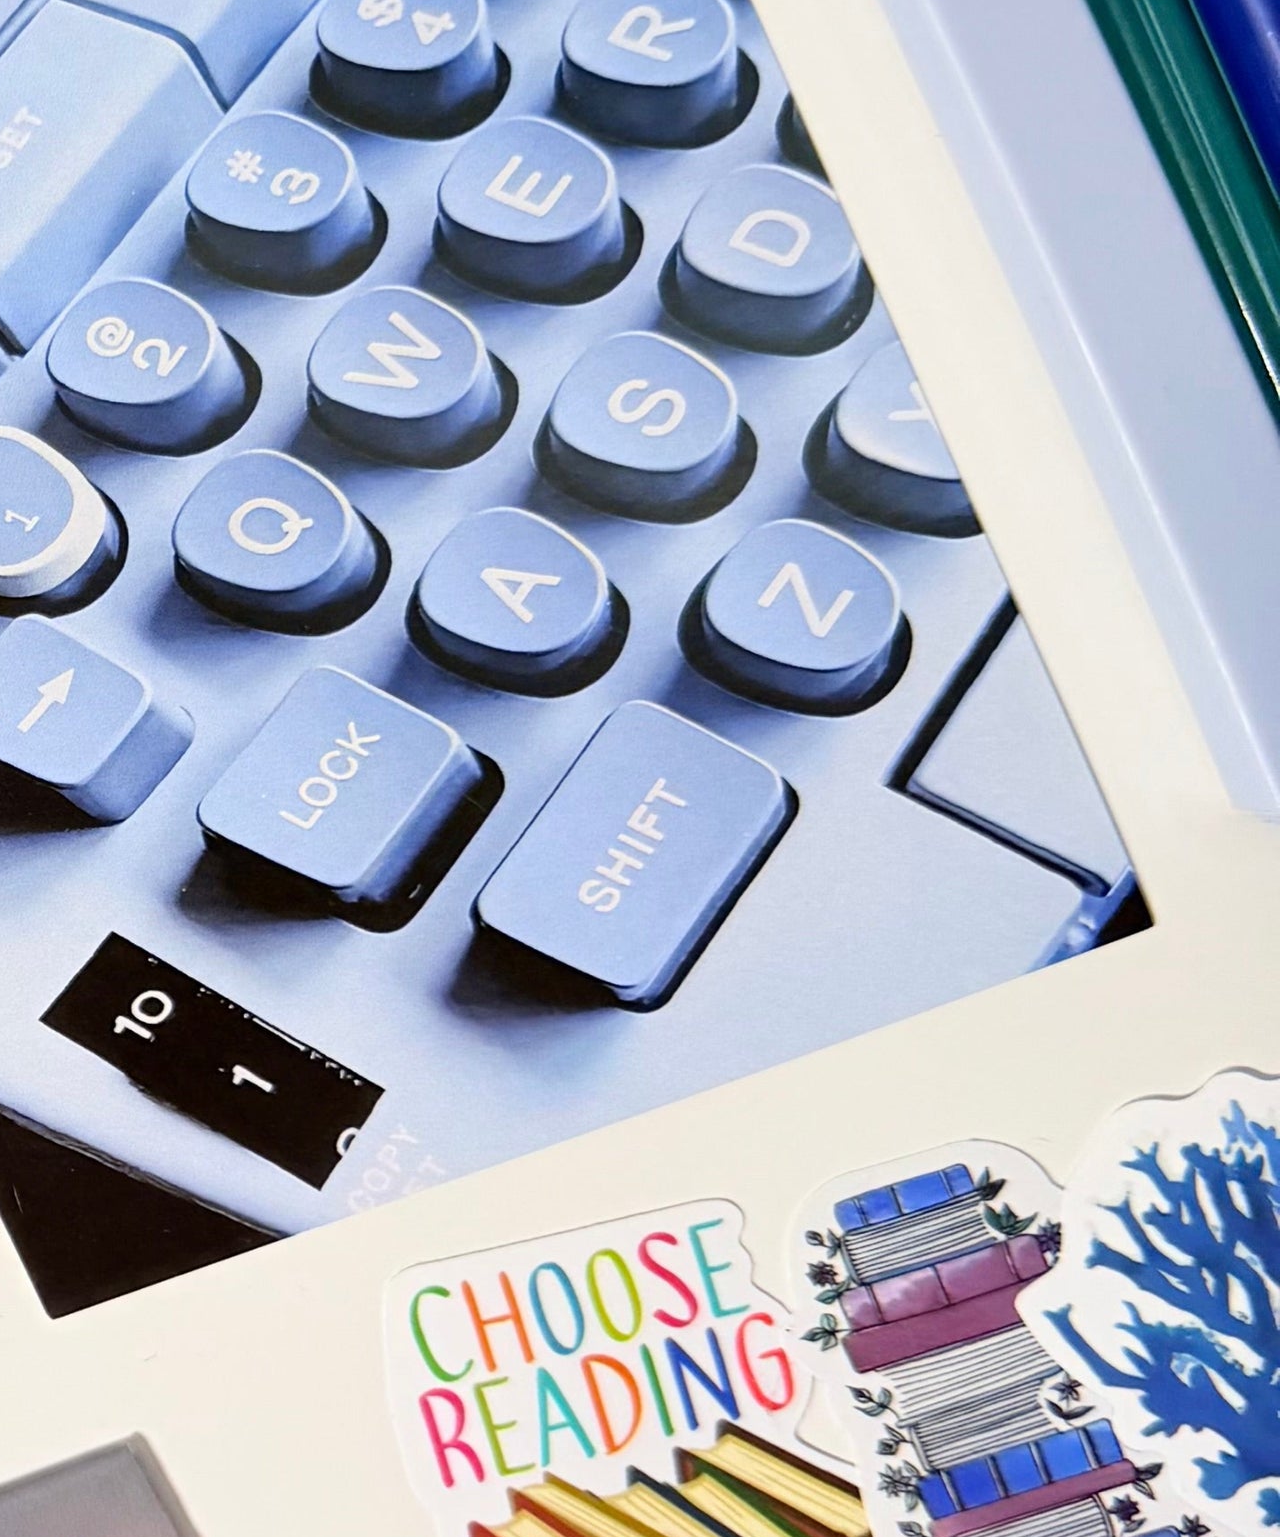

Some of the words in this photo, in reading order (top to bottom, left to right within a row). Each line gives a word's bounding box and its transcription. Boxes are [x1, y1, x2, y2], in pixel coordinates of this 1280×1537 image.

[607, 4, 696, 63] R
[483, 154, 574, 219] E
[728, 209, 811, 268] D
[342, 312, 443, 390] W
[606, 377, 687, 438] S
[227, 496, 315, 556] Q
[479, 562, 563, 624] A
[756, 561, 856, 639] Z
[278, 720, 382, 832] LOCK
[578, 777, 689, 914] SHIFT
[113, 989, 175, 1042] 10
[408, 1217, 751, 1384] CHOOSE
[417, 1311, 796, 1489] READING
